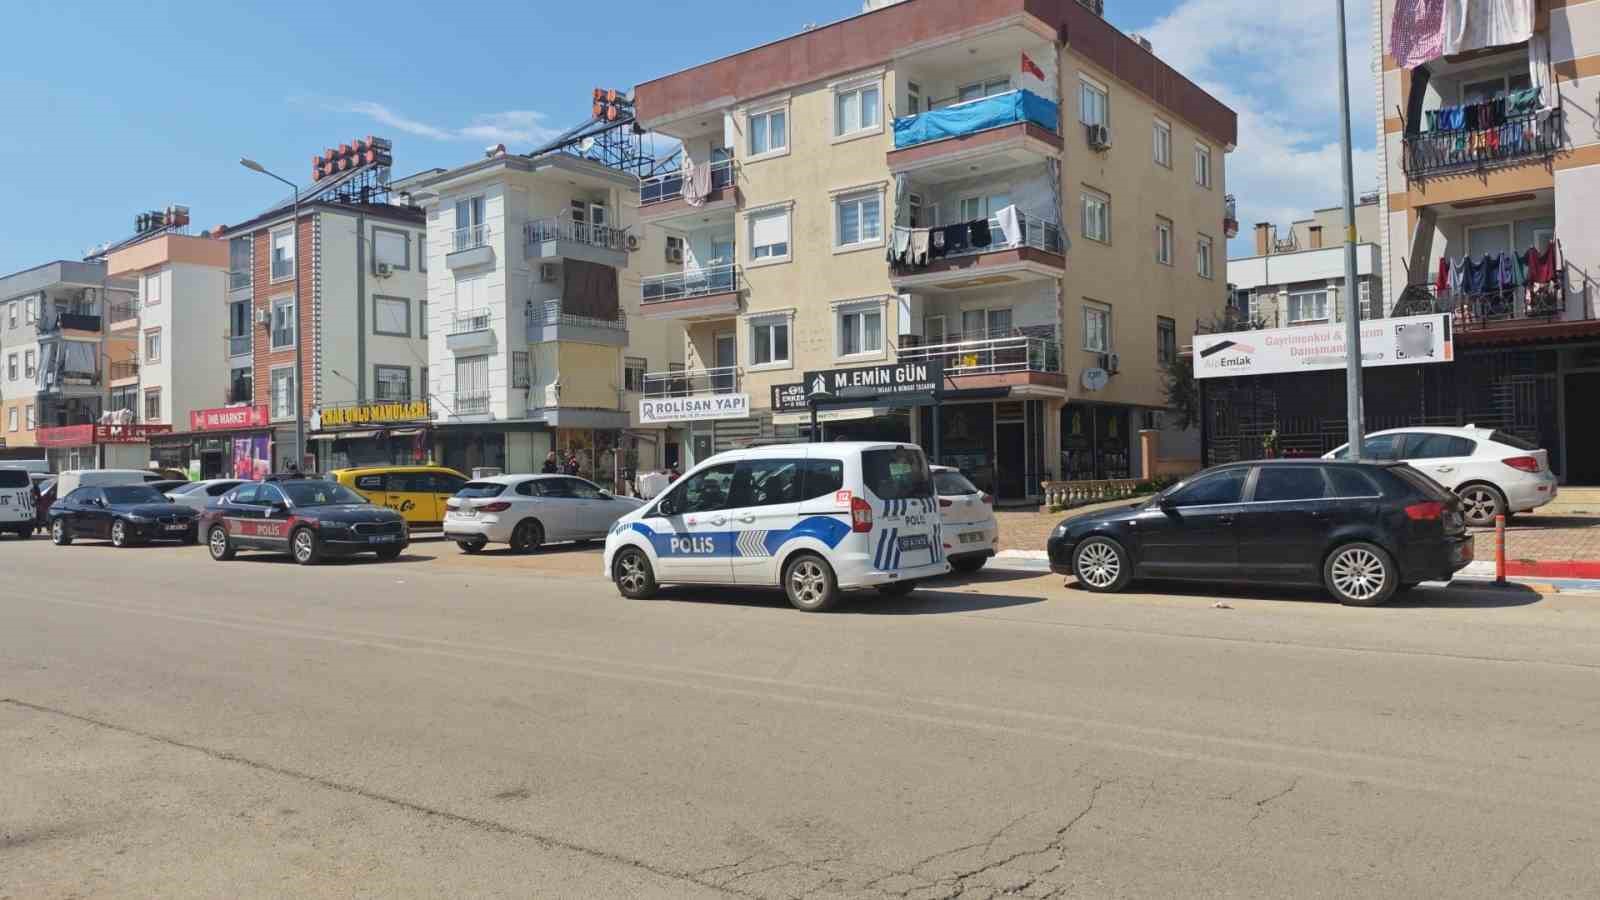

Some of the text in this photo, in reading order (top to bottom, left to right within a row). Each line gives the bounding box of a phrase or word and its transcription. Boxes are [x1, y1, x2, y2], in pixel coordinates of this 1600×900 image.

[1220, 355, 1251, 367] Emlak
[896, 363, 927, 383] GÜN
[656, 400, 711, 413] ROLİSAN
[716, 397, 746, 409] YAPI
[220, 410, 247, 425] MARKET
